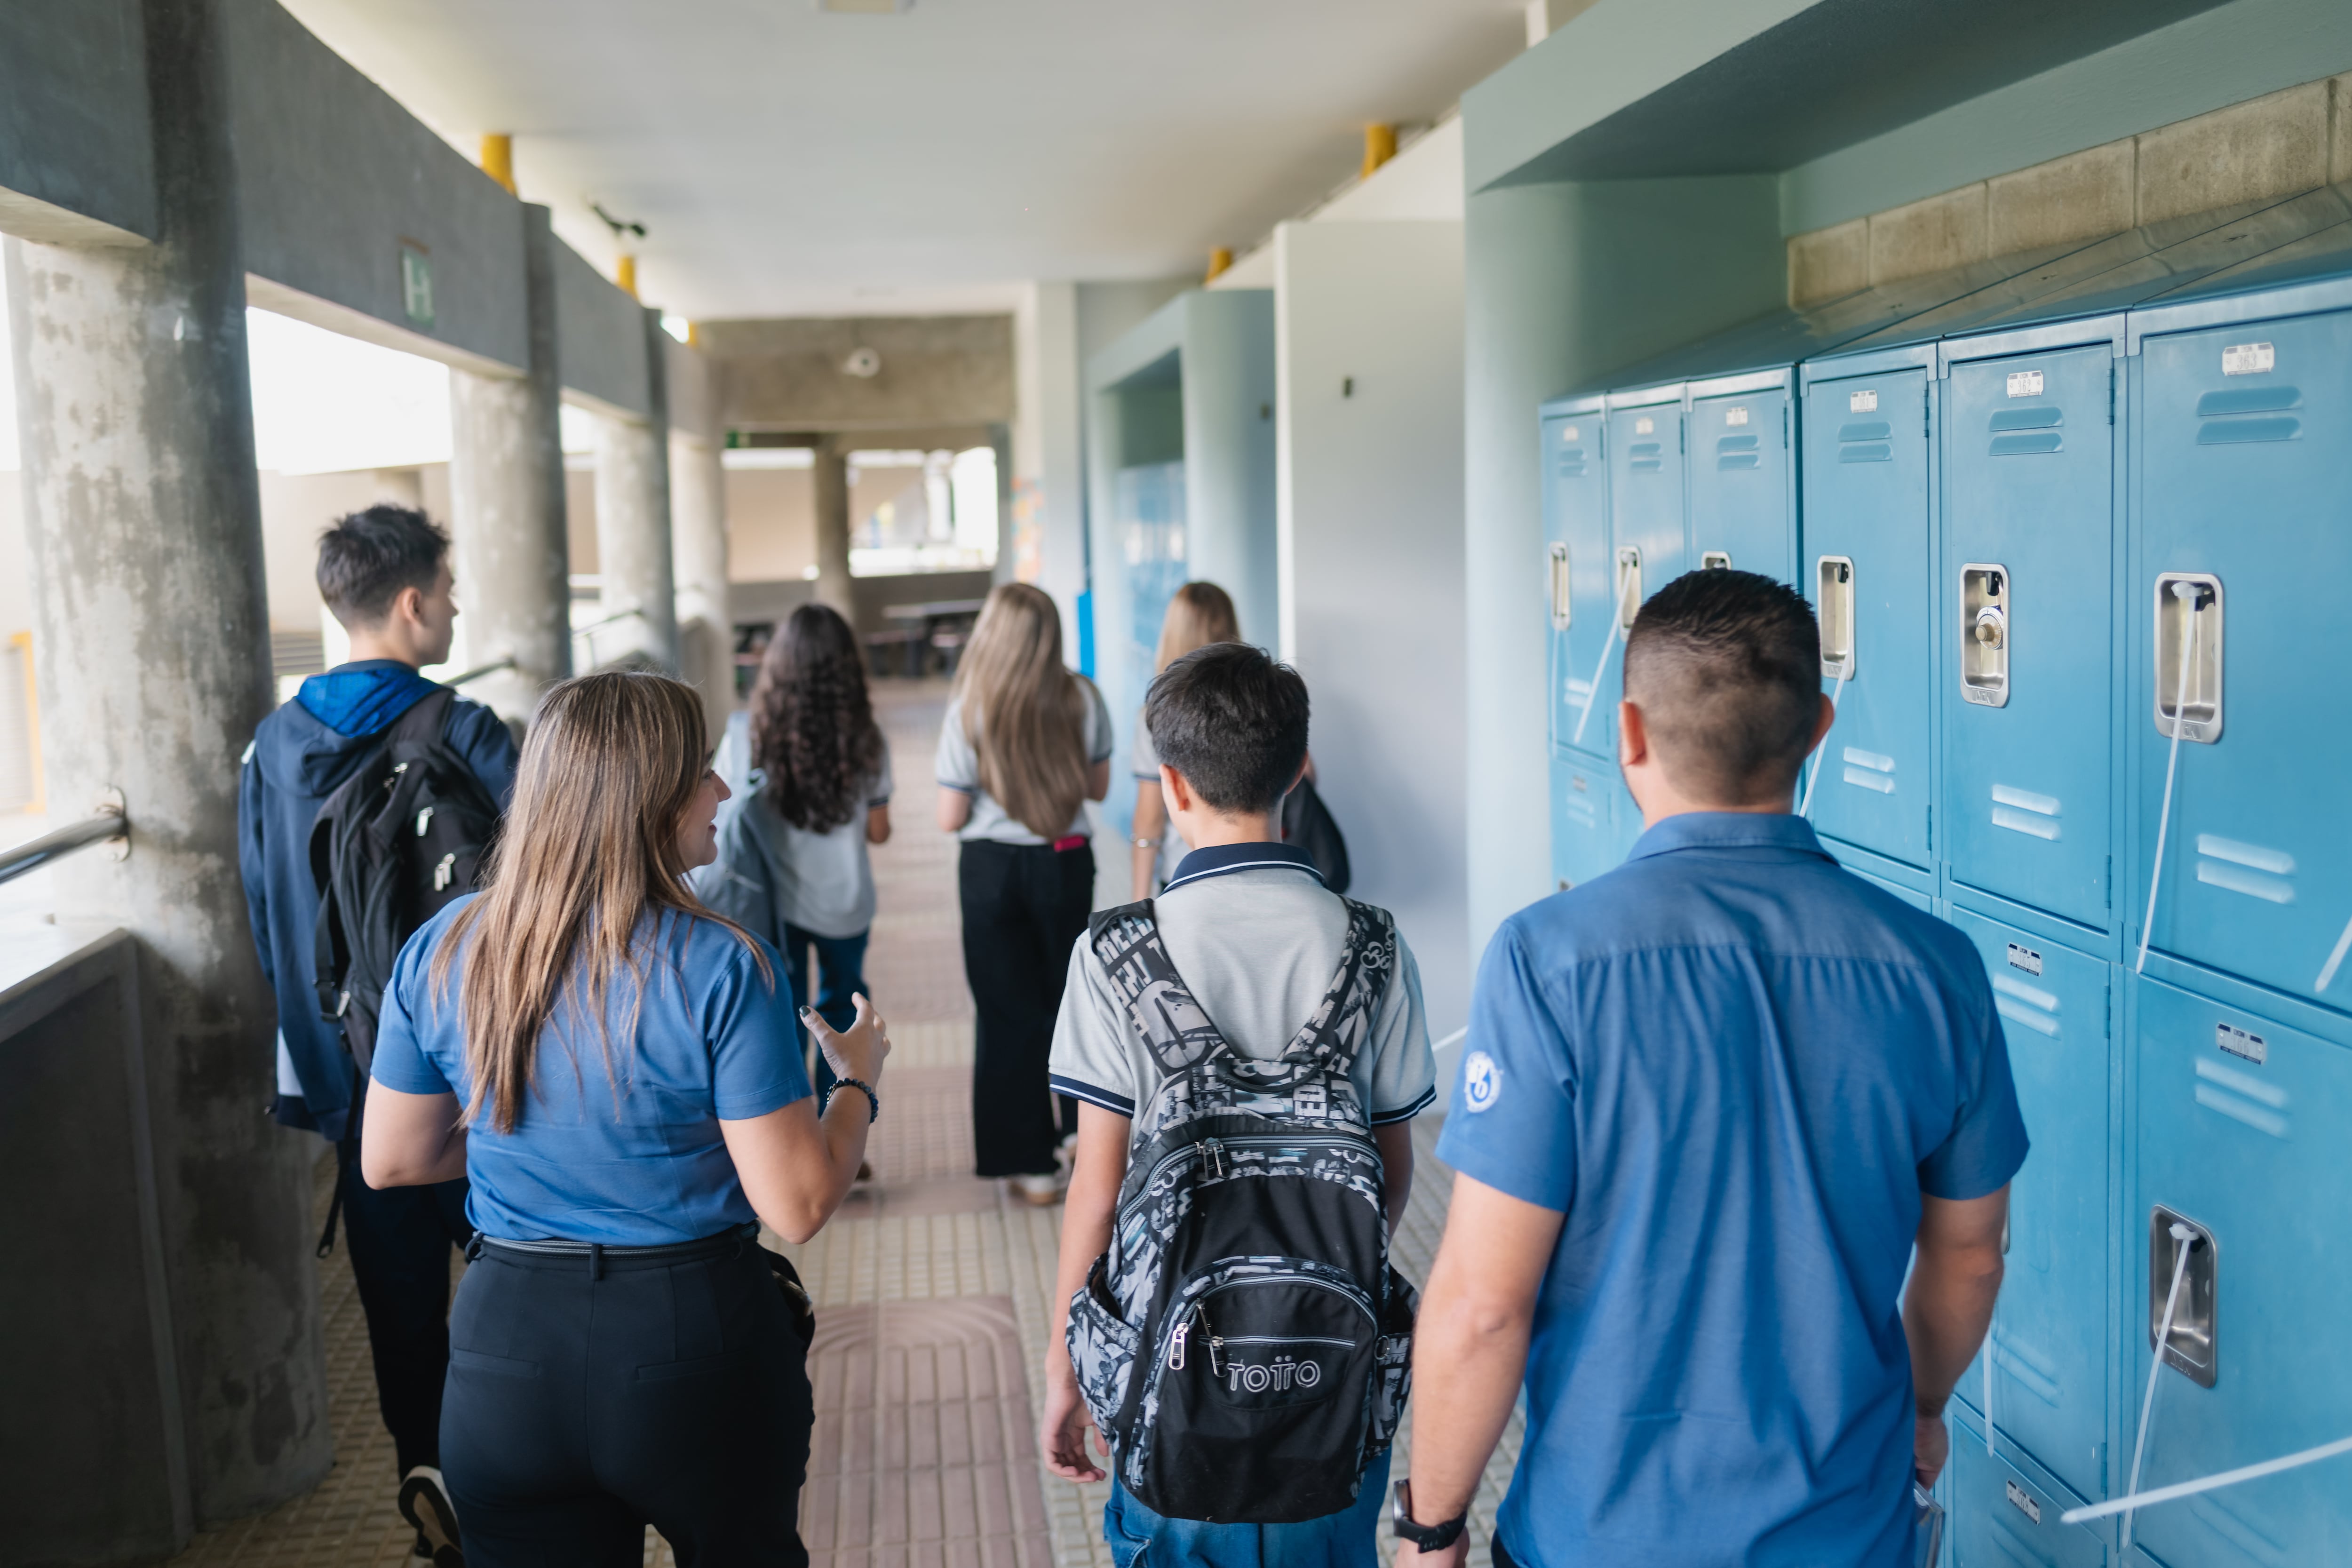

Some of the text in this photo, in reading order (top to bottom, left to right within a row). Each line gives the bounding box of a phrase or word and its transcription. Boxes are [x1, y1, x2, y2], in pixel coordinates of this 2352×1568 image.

[2237, 352, 2257, 370] 363
[2018, 379, 2031, 393] 362
[2231, 1036, 2249, 1055] 366
[1226, 1355, 1321, 1393] TOTTO
